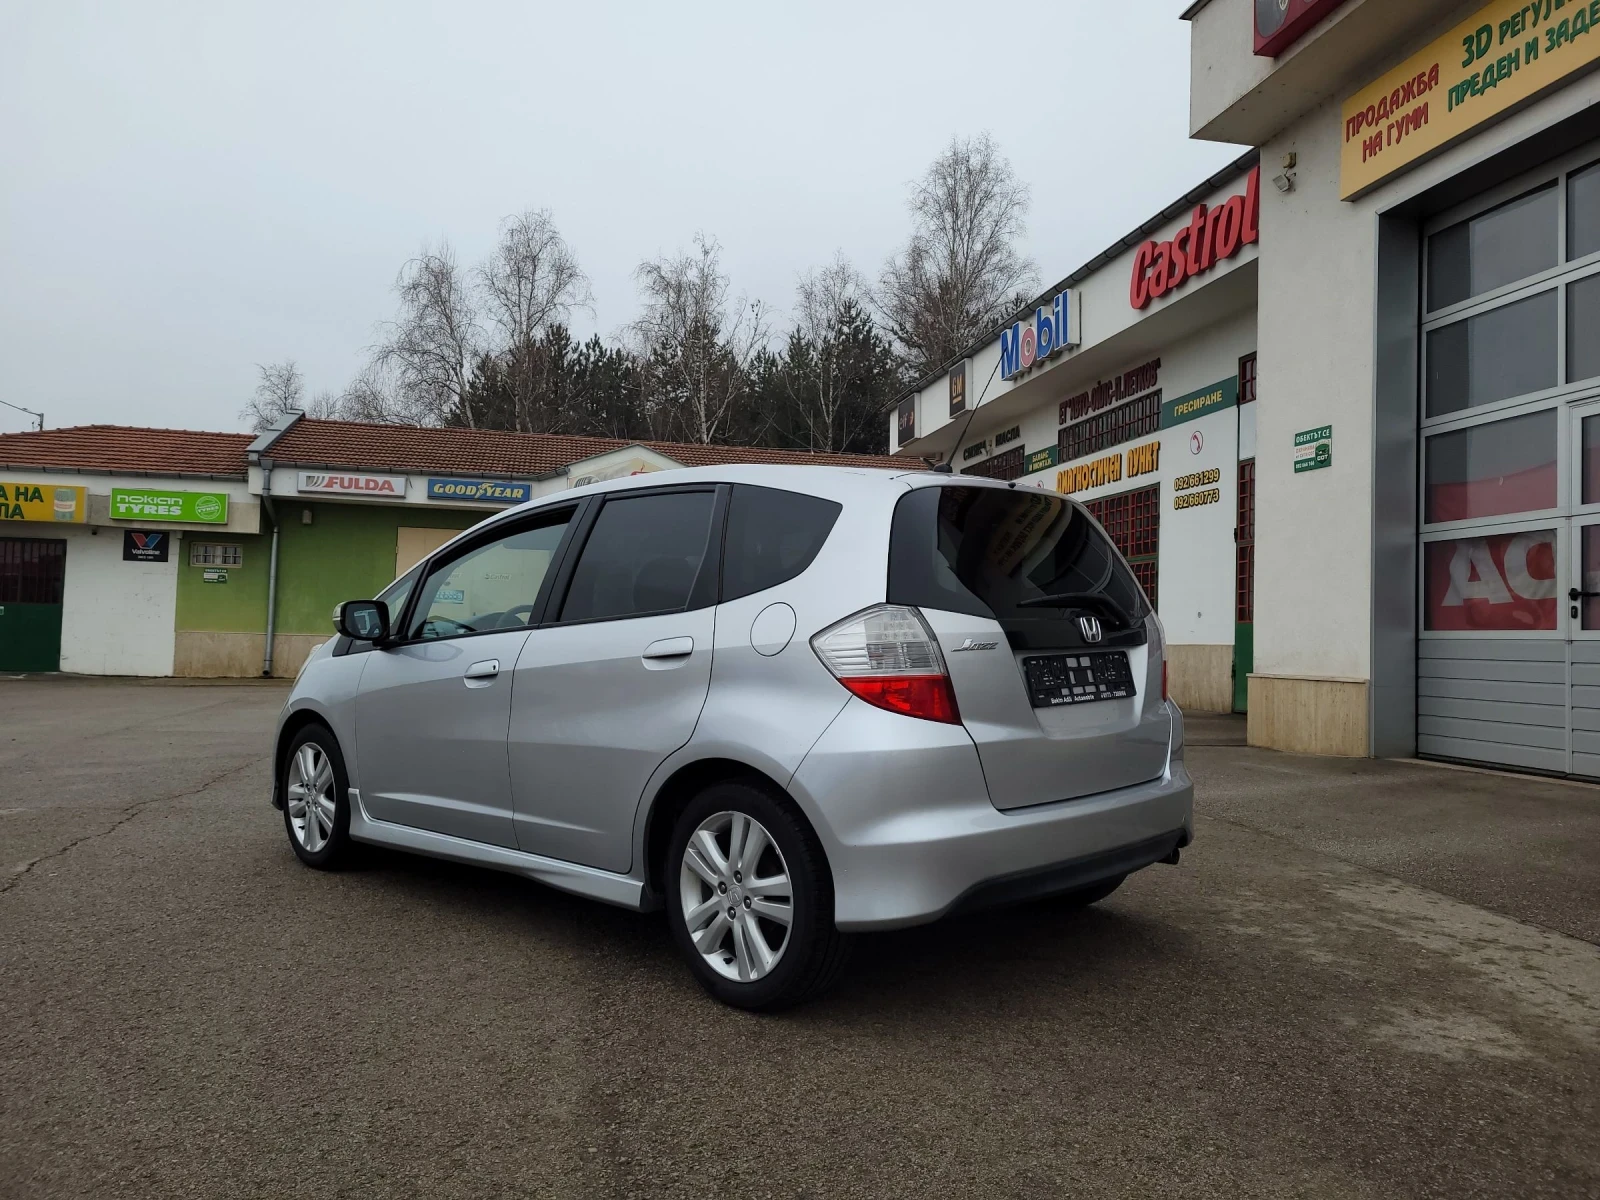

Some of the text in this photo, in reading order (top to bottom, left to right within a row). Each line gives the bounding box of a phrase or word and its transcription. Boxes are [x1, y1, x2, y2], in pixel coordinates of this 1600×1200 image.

[1462, 24, 1492, 68] 3D
[1448, 47, 1520, 112] ПРЕДЕН
[1525, 36, 1539, 65] И
[1346, 62, 1440, 143] ПРОДАЖБА
[1362, 101, 1429, 163] НА ГУМИ
[1130, 165, 1260, 310] Castrol
[1001, 289, 1071, 381] Mobil
[952, 374, 963, 397] GM
[1174, 390, 1223, 417] ГРЕСИРАНЕ
[1296, 431, 1321, 443] ОБЕКТЪТ
[1322, 428, 1330, 437] СЕ
[1127, 441, 1161, 478] ПУНКТ
[324, 476, 395, 492] FULDA
[1174, 468, 1220, 491] 092/661299
[15, 486, 44, 503] НА
[1174, 488, 1219, 510] 092/660773
[117, 504, 181, 515] TYRES
[951, 639, 999, 652] Jazz
